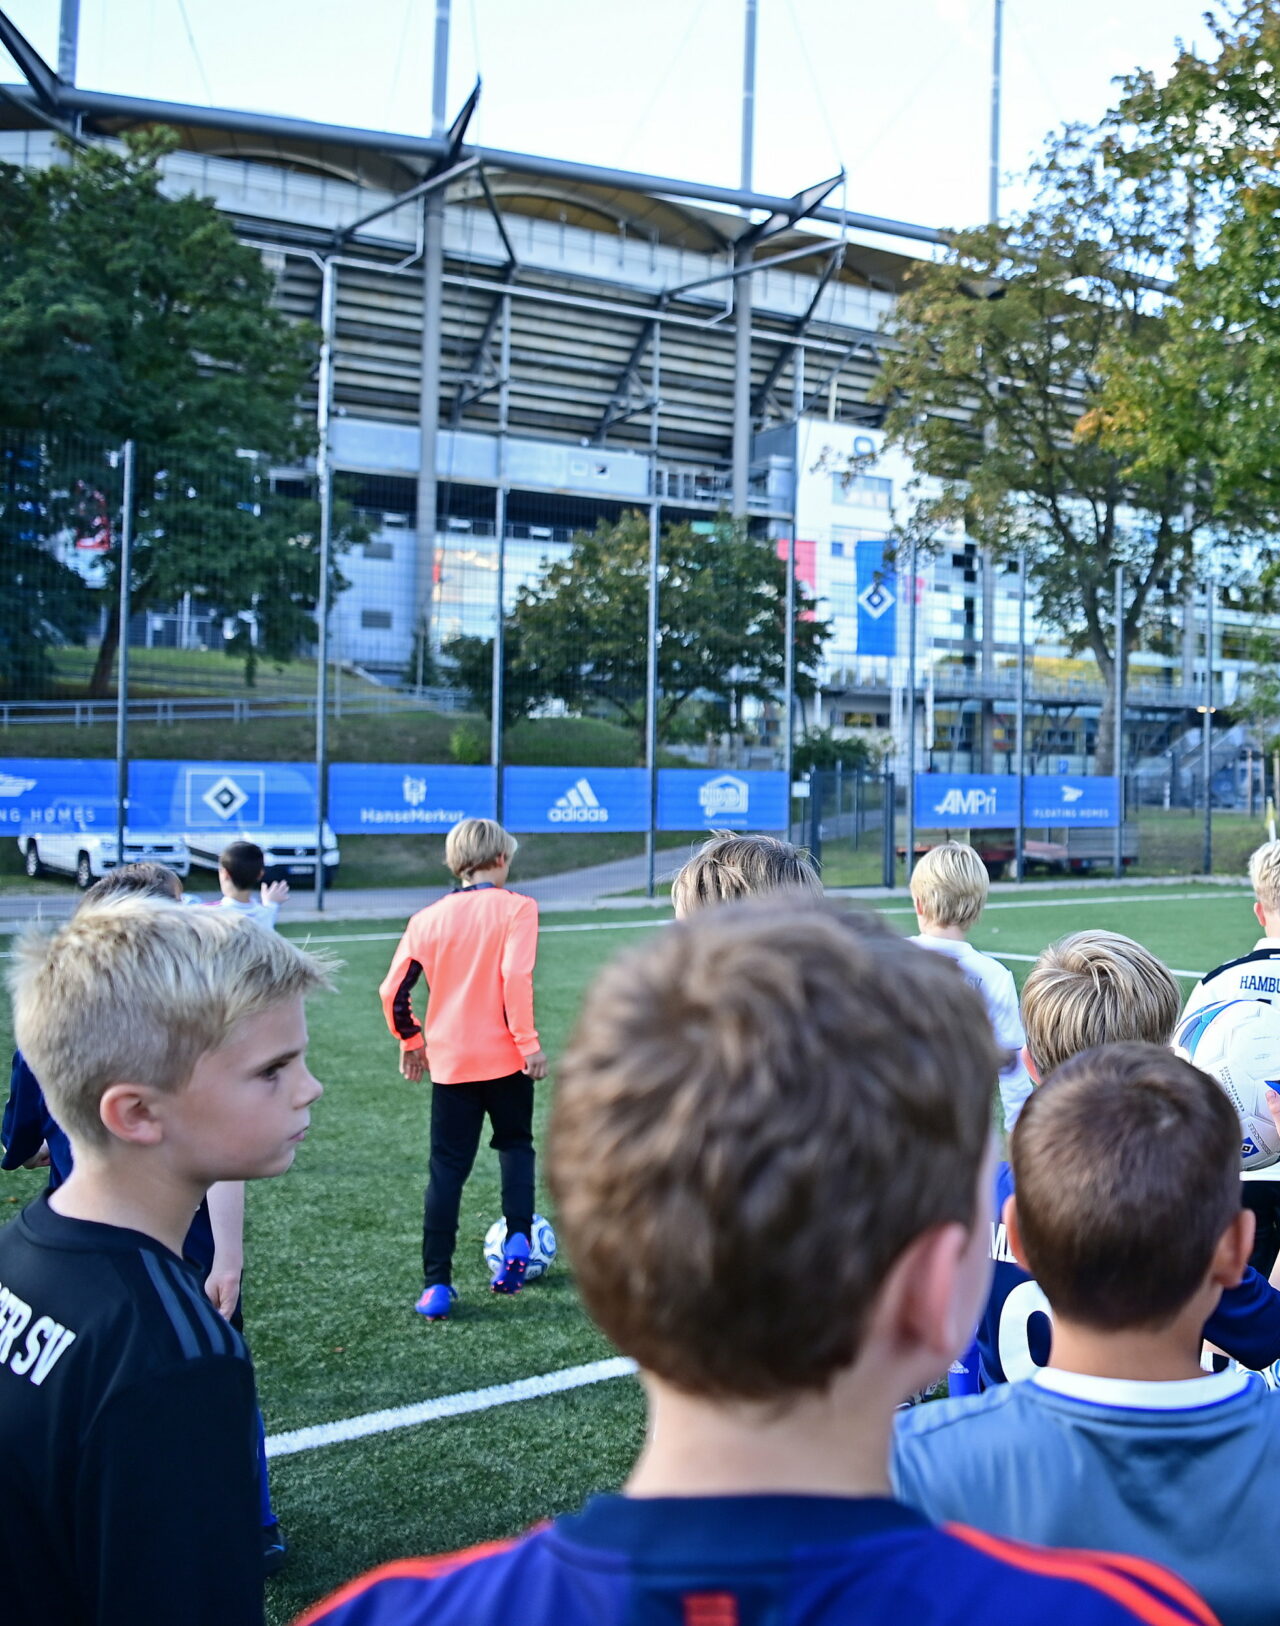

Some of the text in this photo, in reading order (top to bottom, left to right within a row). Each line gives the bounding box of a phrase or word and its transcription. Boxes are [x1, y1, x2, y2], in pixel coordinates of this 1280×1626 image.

[933, 787, 997, 815] AMPri
[30, 807, 96, 823] HOMES
[361, 808, 465, 823] HanseMerkur
[548, 807, 608, 822] adidas
[1033, 808, 1109, 818] FLOATING HOMES
[10, 1315, 77, 1386] SV
